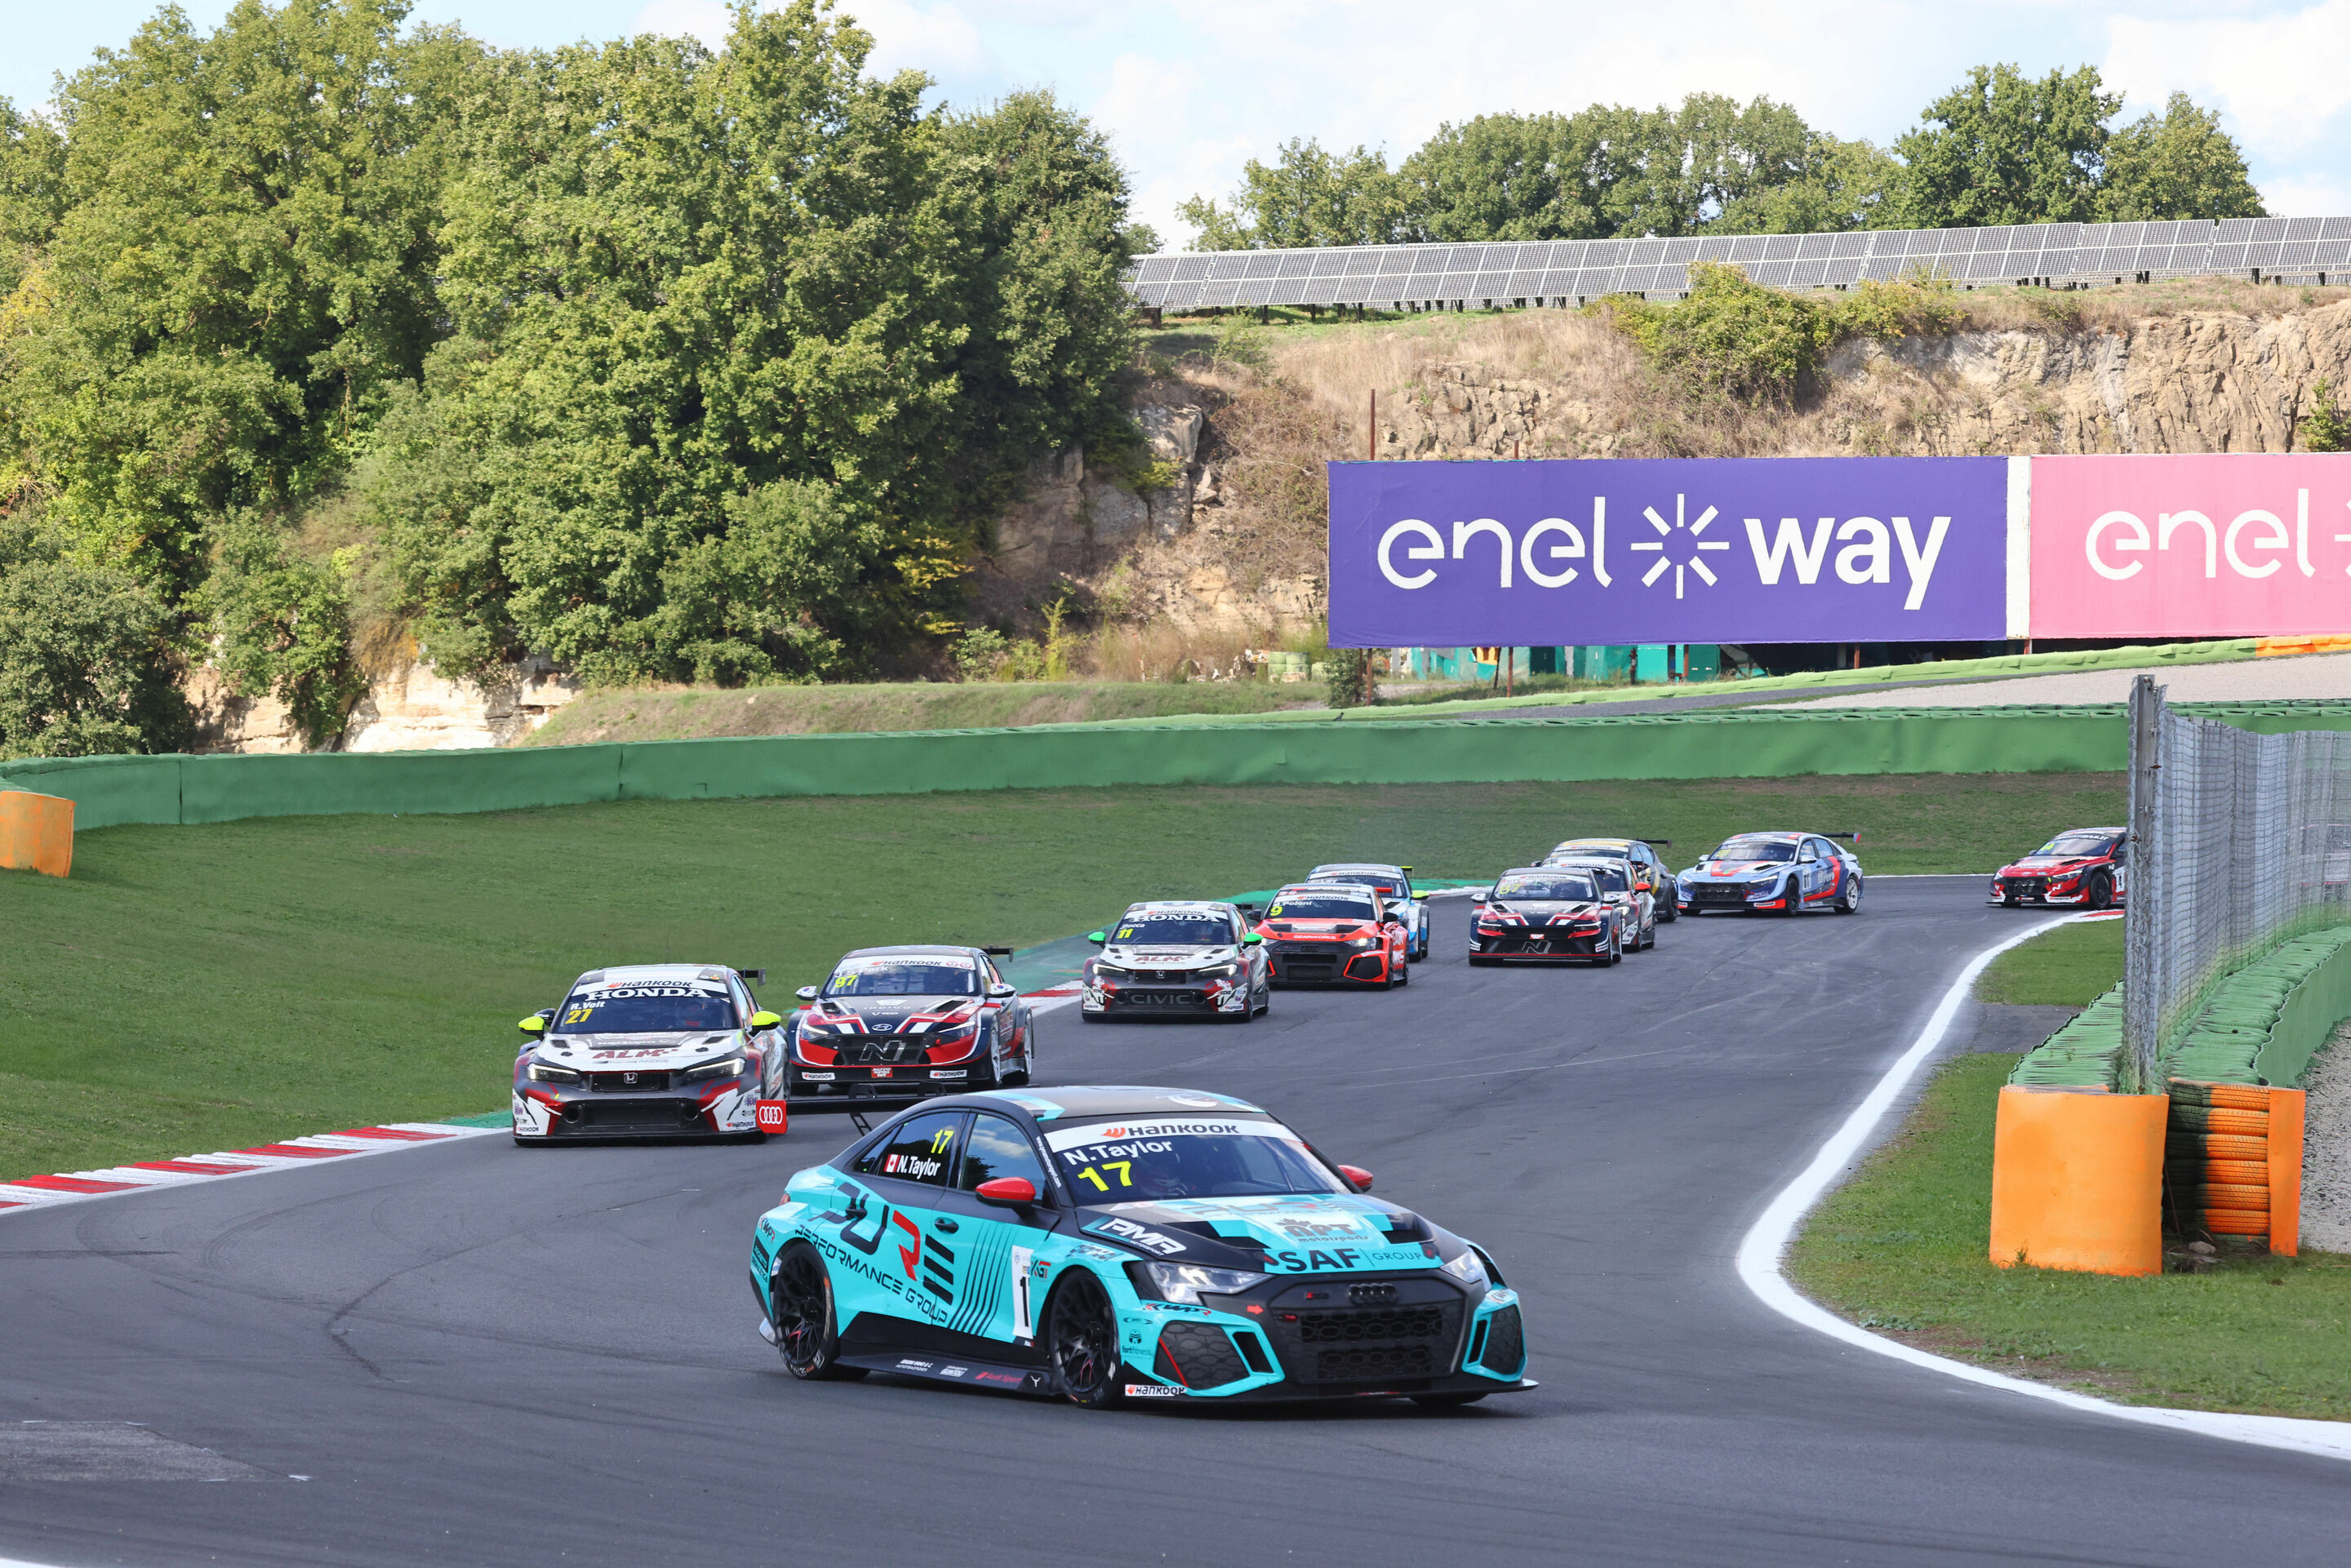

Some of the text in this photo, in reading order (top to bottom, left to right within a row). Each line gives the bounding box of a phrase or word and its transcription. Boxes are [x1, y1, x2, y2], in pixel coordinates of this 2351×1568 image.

[2085, 488, 2315, 581] enel
[1377, 495, 1952, 611] enel way
[1131, 913, 1221, 922] HONDA
[1269, 905, 1283, 917] 9
[1118, 927, 1134, 939] 11
[834, 974, 859, 988] 97
[570, 1001, 606, 1011] R.Volt
[584, 987, 712, 1002] HONDA
[1130, 994, 1190, 1005] CIVIC
[931, 1129, 955, 1154] 17
[1063, 1139, 1173, 1166] N.Taylor
[896, 1154, 941, 1179] N.Taylor
[1077, 1160, 1133, 1193] 17
[1298, 1235, 1369, 1243] motorsports
[1277, 1248, 1422, 1273] SAF GROUP
[794, 1224, 904, 1295] PERFORMANCE
[905, 1287, 949, 1323] GROUP
[1020, 1276, 1030, 1327] 1
